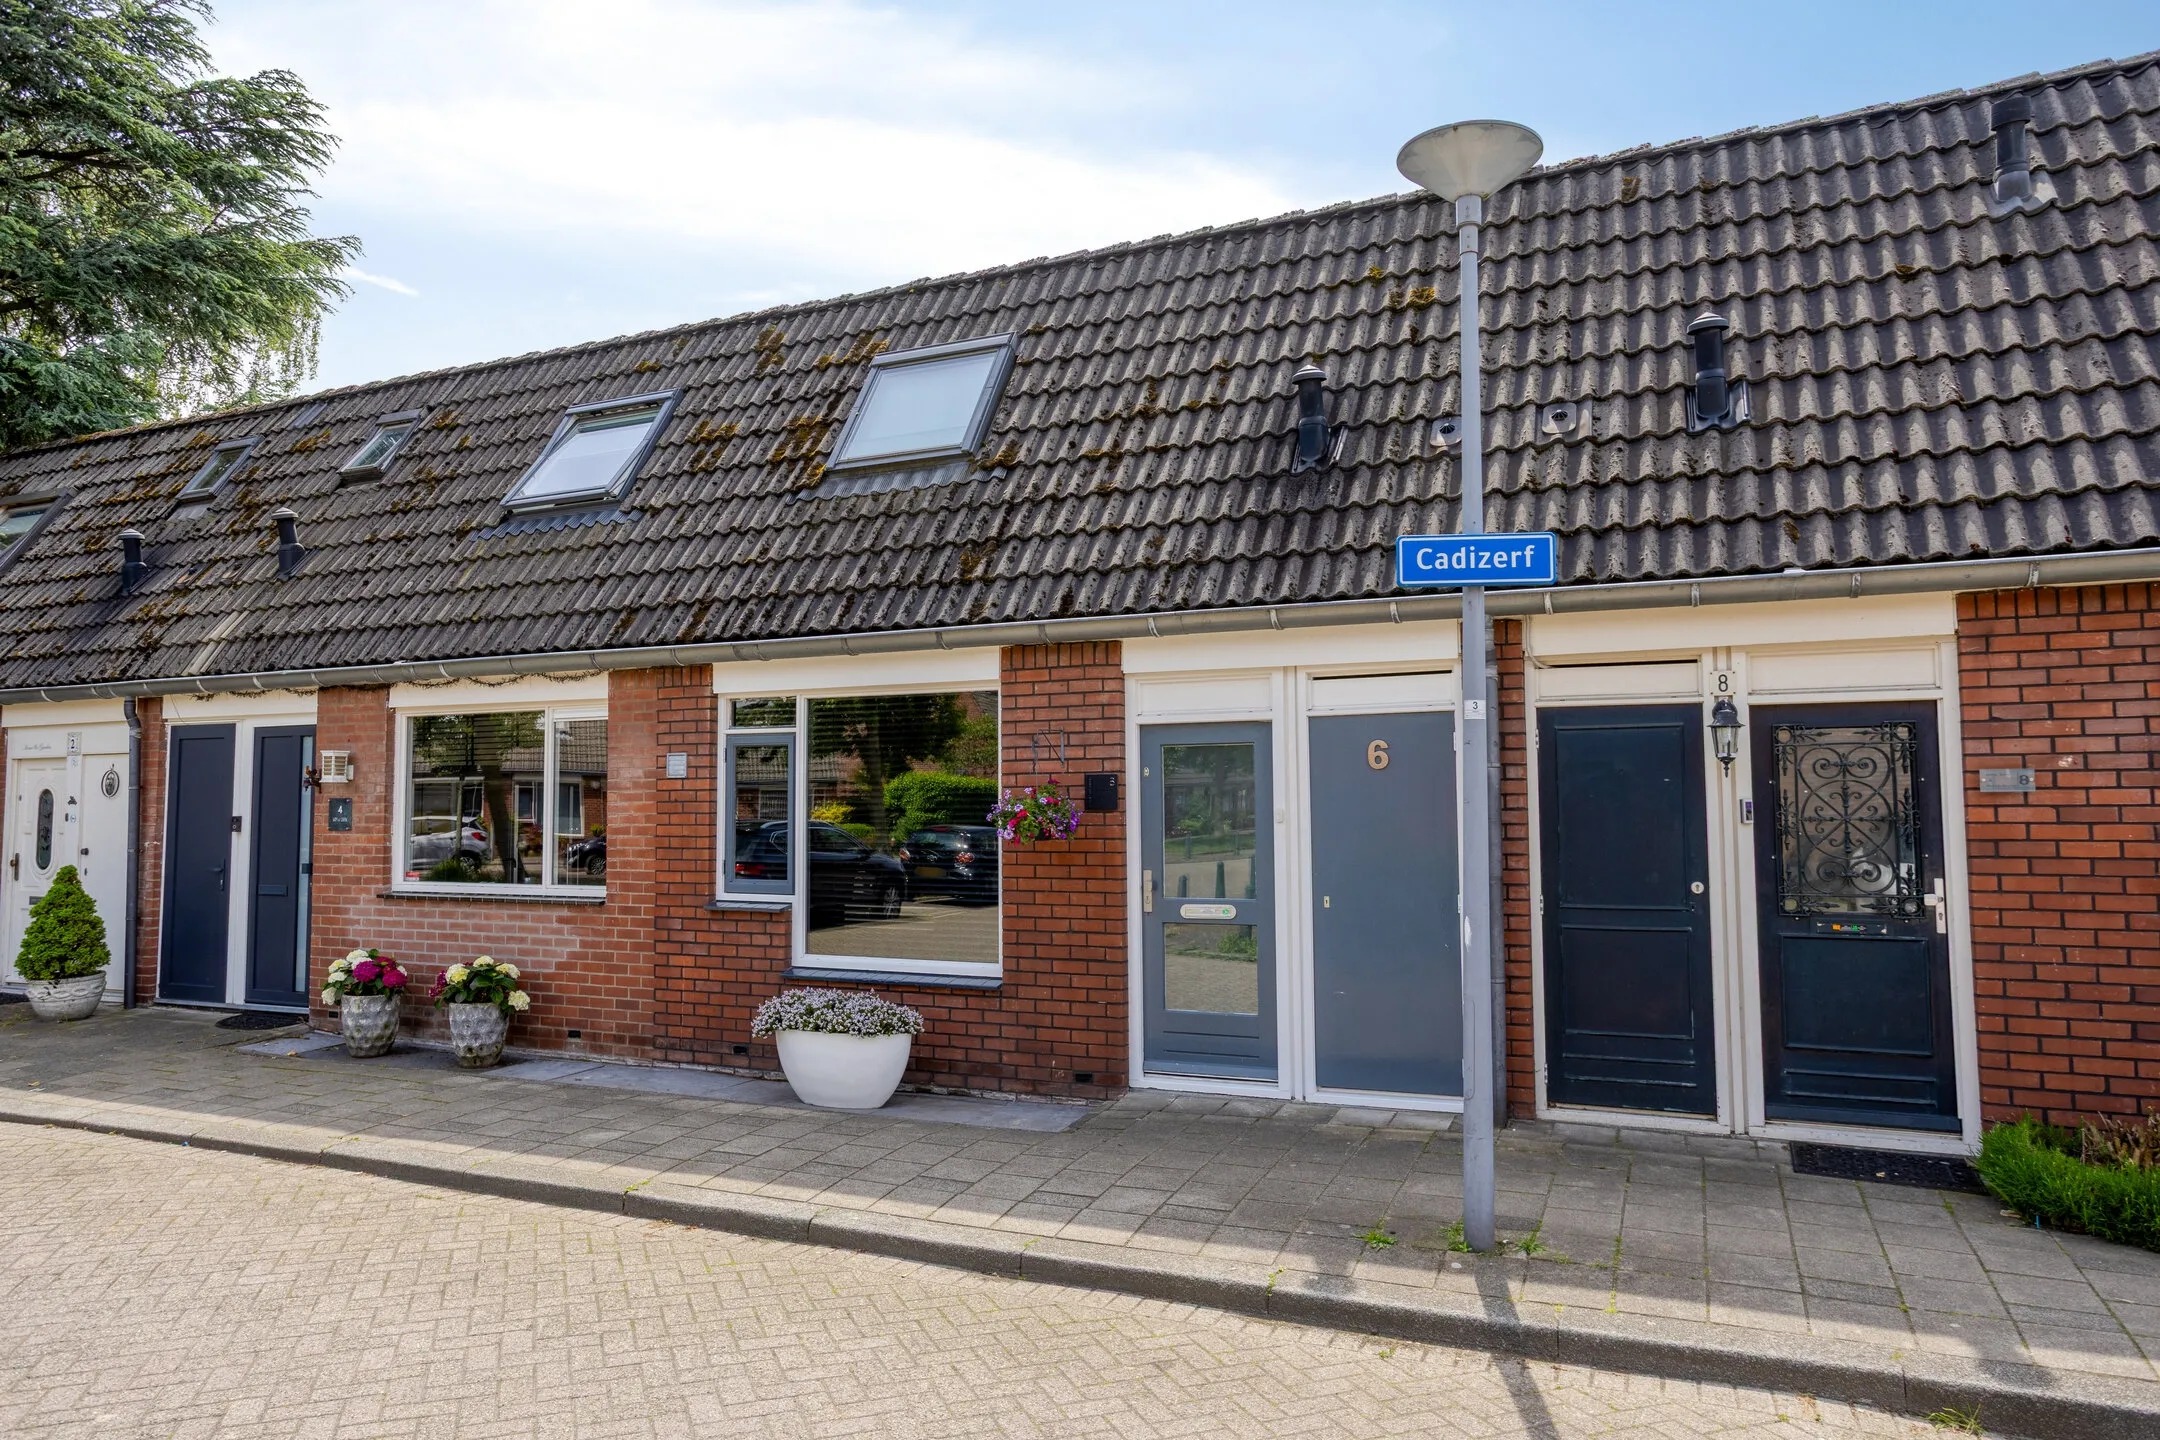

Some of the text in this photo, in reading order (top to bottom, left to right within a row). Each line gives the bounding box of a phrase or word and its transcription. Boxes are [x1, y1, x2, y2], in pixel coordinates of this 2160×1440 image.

[1416, 545, 1536, 570] Cadizerf
[1718, 674, 1728, 692] 8
[1472, 701, 1478, 710] 3
[70, 738, 75, 749] 2
[1367, 739, 1389, 770] 6
[2019, 774, 2029, 785] 8
[337, 805, 343, 814] 4
